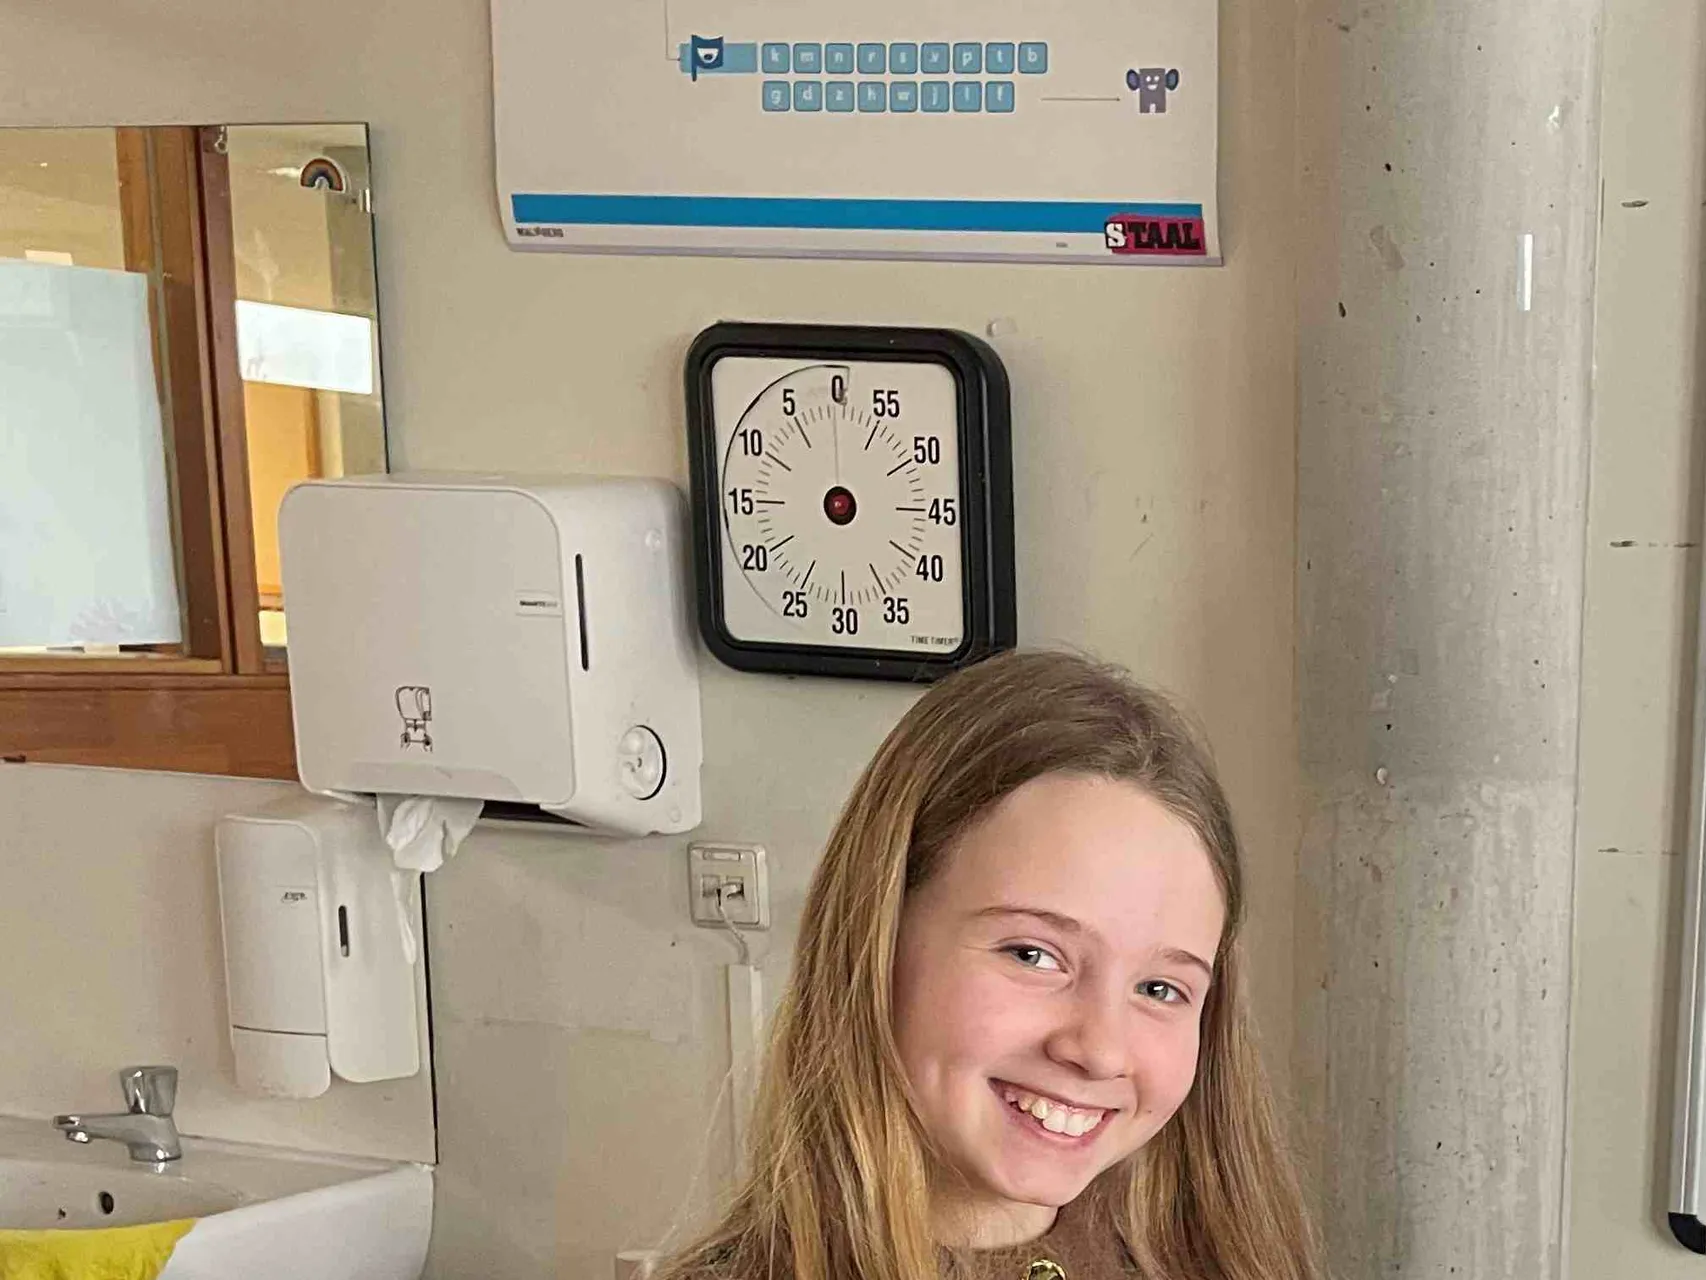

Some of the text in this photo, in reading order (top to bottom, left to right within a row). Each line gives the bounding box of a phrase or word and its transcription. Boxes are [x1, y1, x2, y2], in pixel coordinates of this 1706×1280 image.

[1105, 222, 1200, 250] STAAL
[783, 388, 795, 416] 5
[831, 375, 844, 403] 0
[873, 389, 900, 418] 55
[738, 429, 762, 456] 10
[914, 436, 940, 464] 50
[728, 488, 754, 515] 15
[928, 498, 957, 526] 45
[743, 544, 768, 572] 20
[916, 555, 944, 582] 40
[782, 591, 808, 618] 25
[883, 597, 910, 624] 35
[831, 608, 858, 635] 30
